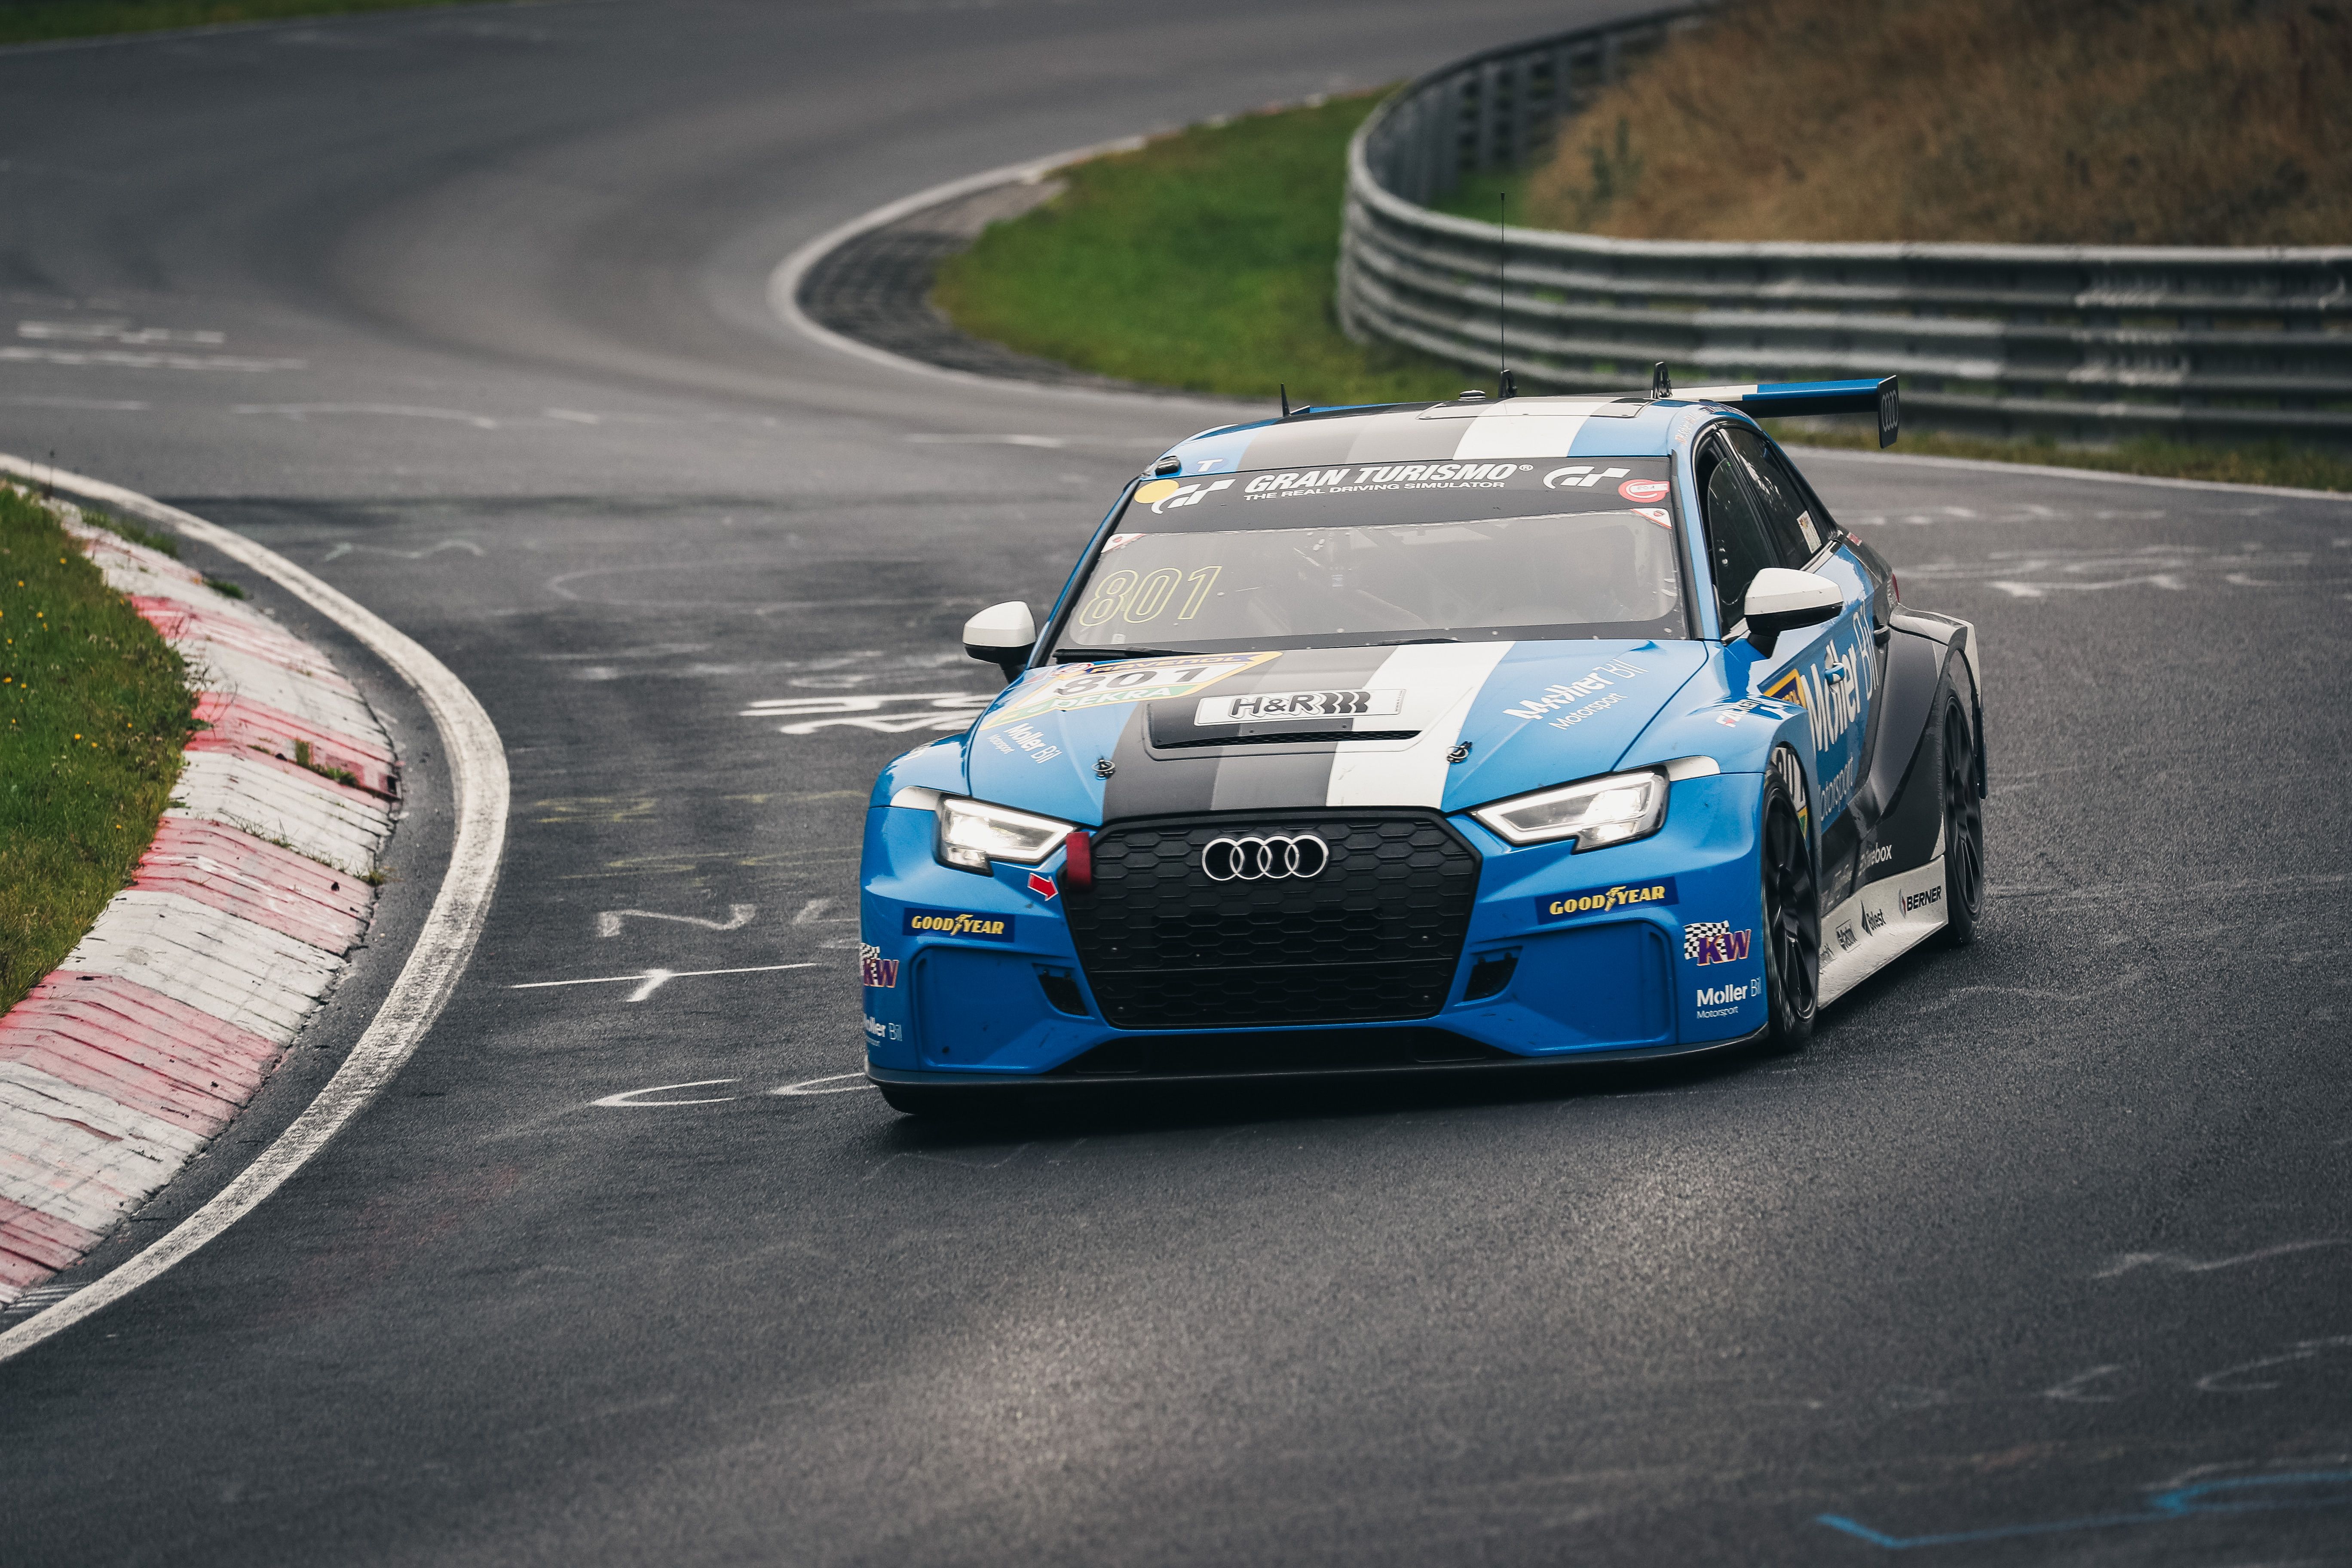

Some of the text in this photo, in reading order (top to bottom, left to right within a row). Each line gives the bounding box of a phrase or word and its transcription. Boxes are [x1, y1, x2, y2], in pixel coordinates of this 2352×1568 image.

[1243, 481, 1505, 501] THE REAL DRIVING SIMULATOR
[1244, 468, 1351, 493] GRAN
[1079, 565, 1222, 627] 801
[1853, 599, 1879, 701] Bil
[1092, 656, 1243, 673] RAVENOL
[1592, 658, 1649, 679] Bil
[1054, 667, 1208, 695] 801
[1051, 687, 1176, 709] DEKRA
[1229, 693, 1319, 717] H&R
[1548, 692, 1628, 730] Motorsport
[1030, 745, 1063, 764] Bil
[1549, 886, 1666, 915] GOODYEAR
[1906, 885, 1942, 912] BERNER
[911, 914, 1004, 936] GOODYEAR
[1697, 929, 1752, 966] KW
[864, 959, 900, 988] KW
[1751, 977, 1761, 996] Bil
[1697, 1006, 1739, 1019] Motorsport
